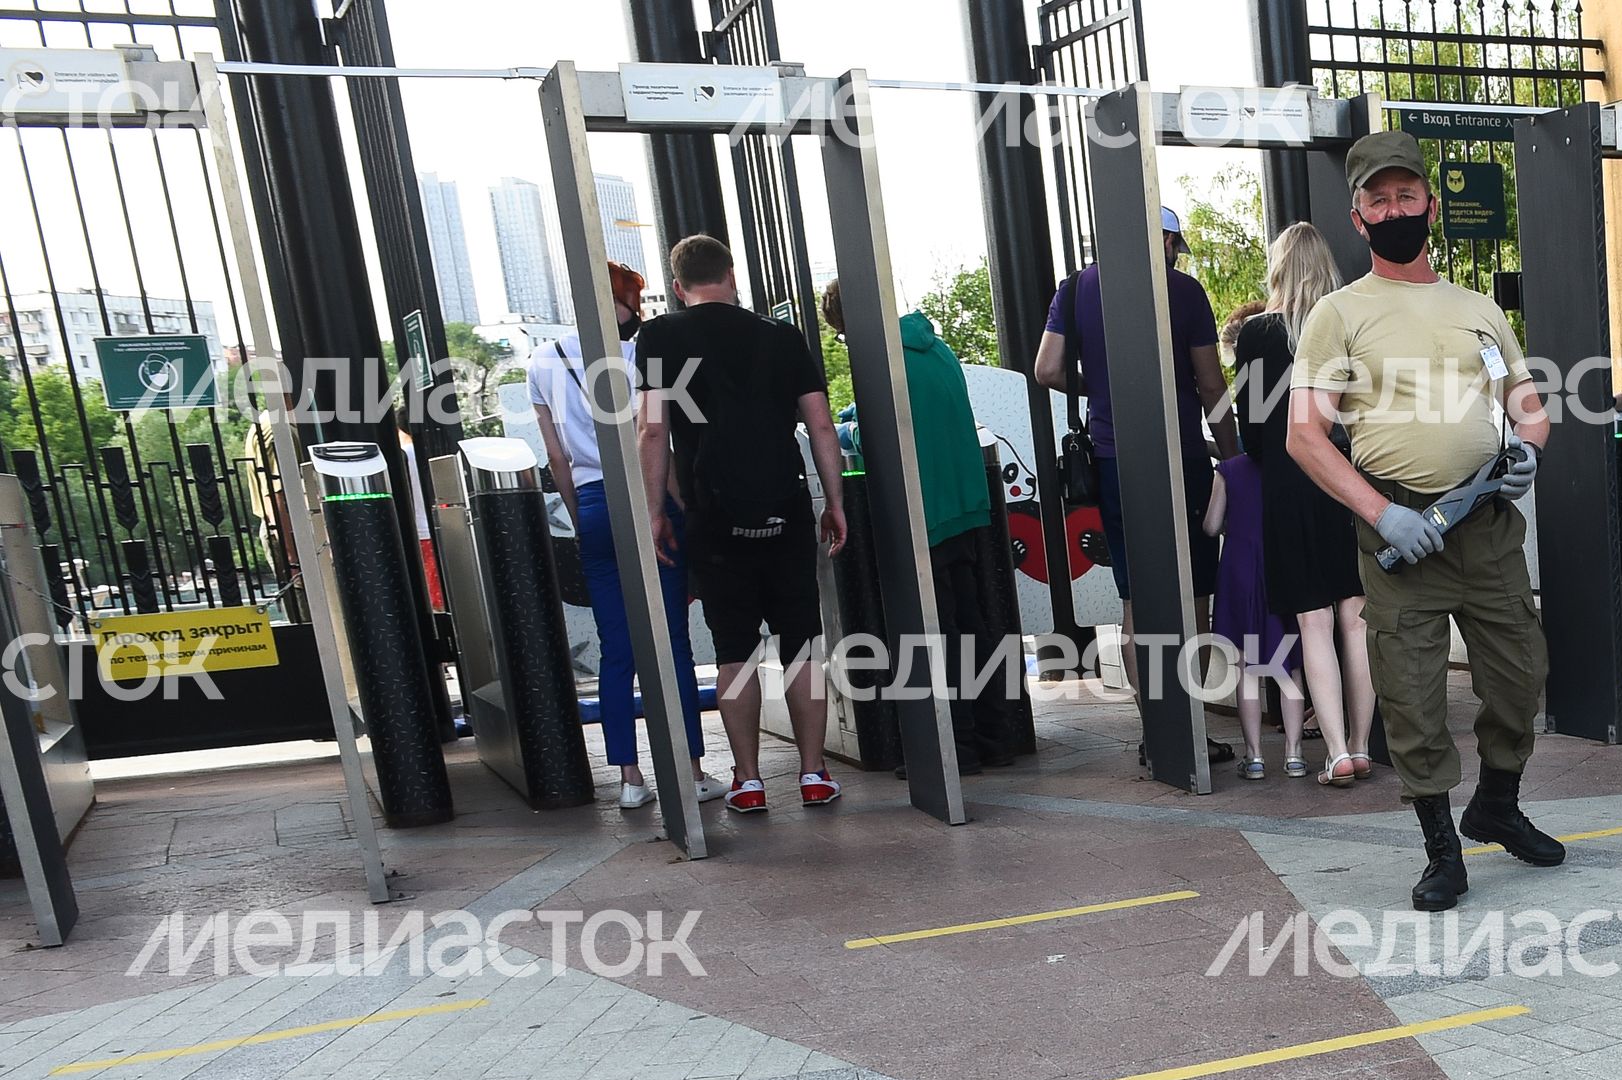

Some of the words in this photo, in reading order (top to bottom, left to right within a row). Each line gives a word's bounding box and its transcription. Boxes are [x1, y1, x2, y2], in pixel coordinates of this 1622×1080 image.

[1423, 112, 1451, 127] Вход
[1455, 114, 1501, 127] Entrance
[102, 626, 186, 649] Проход
[189, 621, 263, 646] закрыт
[109, 656, 125, 666] по
[128, 649, 206, 664] техническим
[208, 643, 268, 657] причинам
